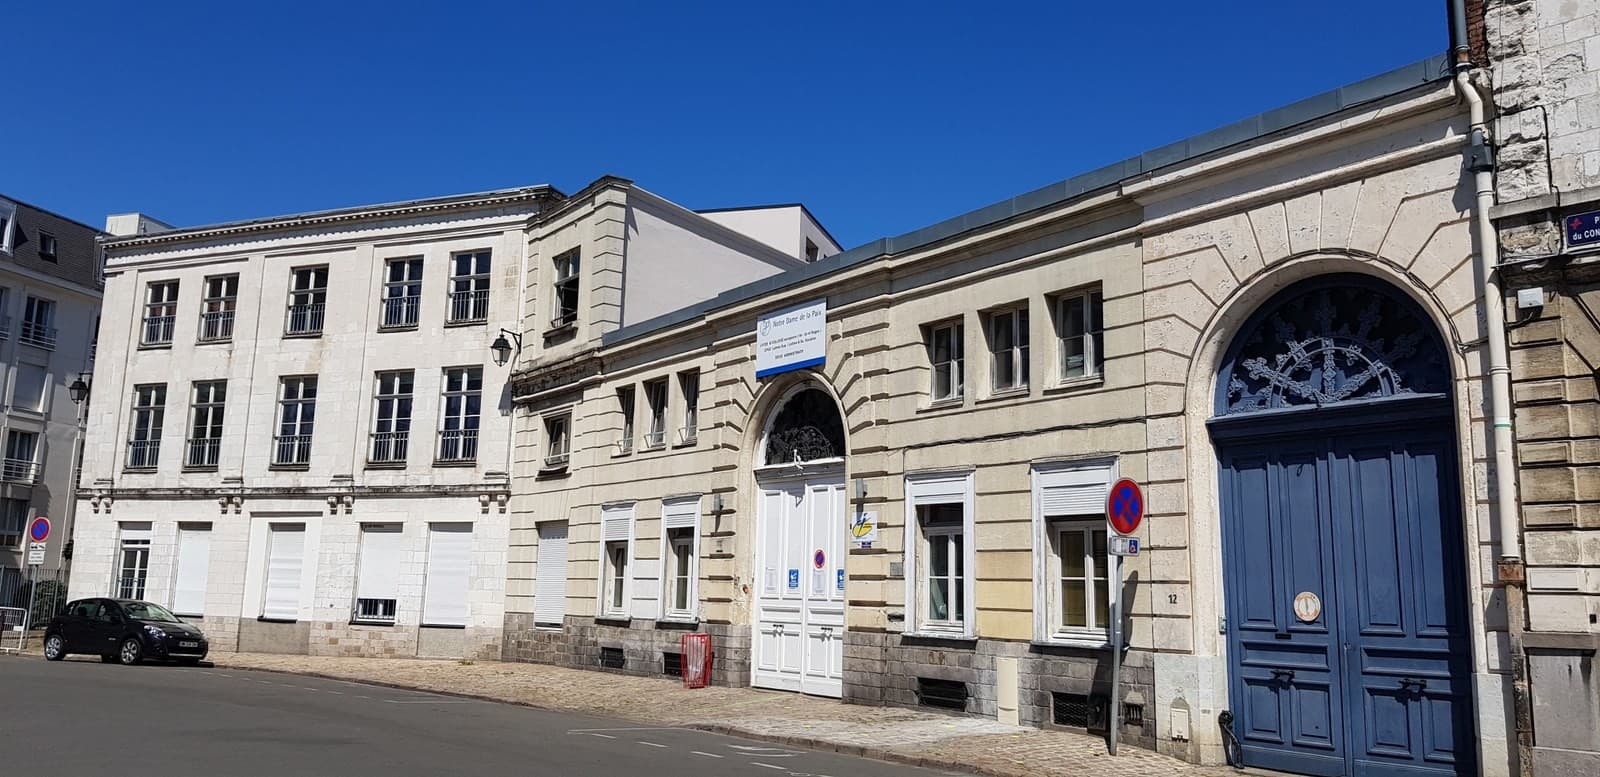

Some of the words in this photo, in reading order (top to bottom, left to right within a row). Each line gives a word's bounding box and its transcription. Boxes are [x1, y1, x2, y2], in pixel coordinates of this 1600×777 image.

[1572, 232, 1582, 240] du
[772, 319, 785, 327] Notre
[786, 316, 798, 325] Dame
[800, 312, 805, 320] de
[806, 311, 811, 319] la
[1168, 594, 1178, 604] 12
